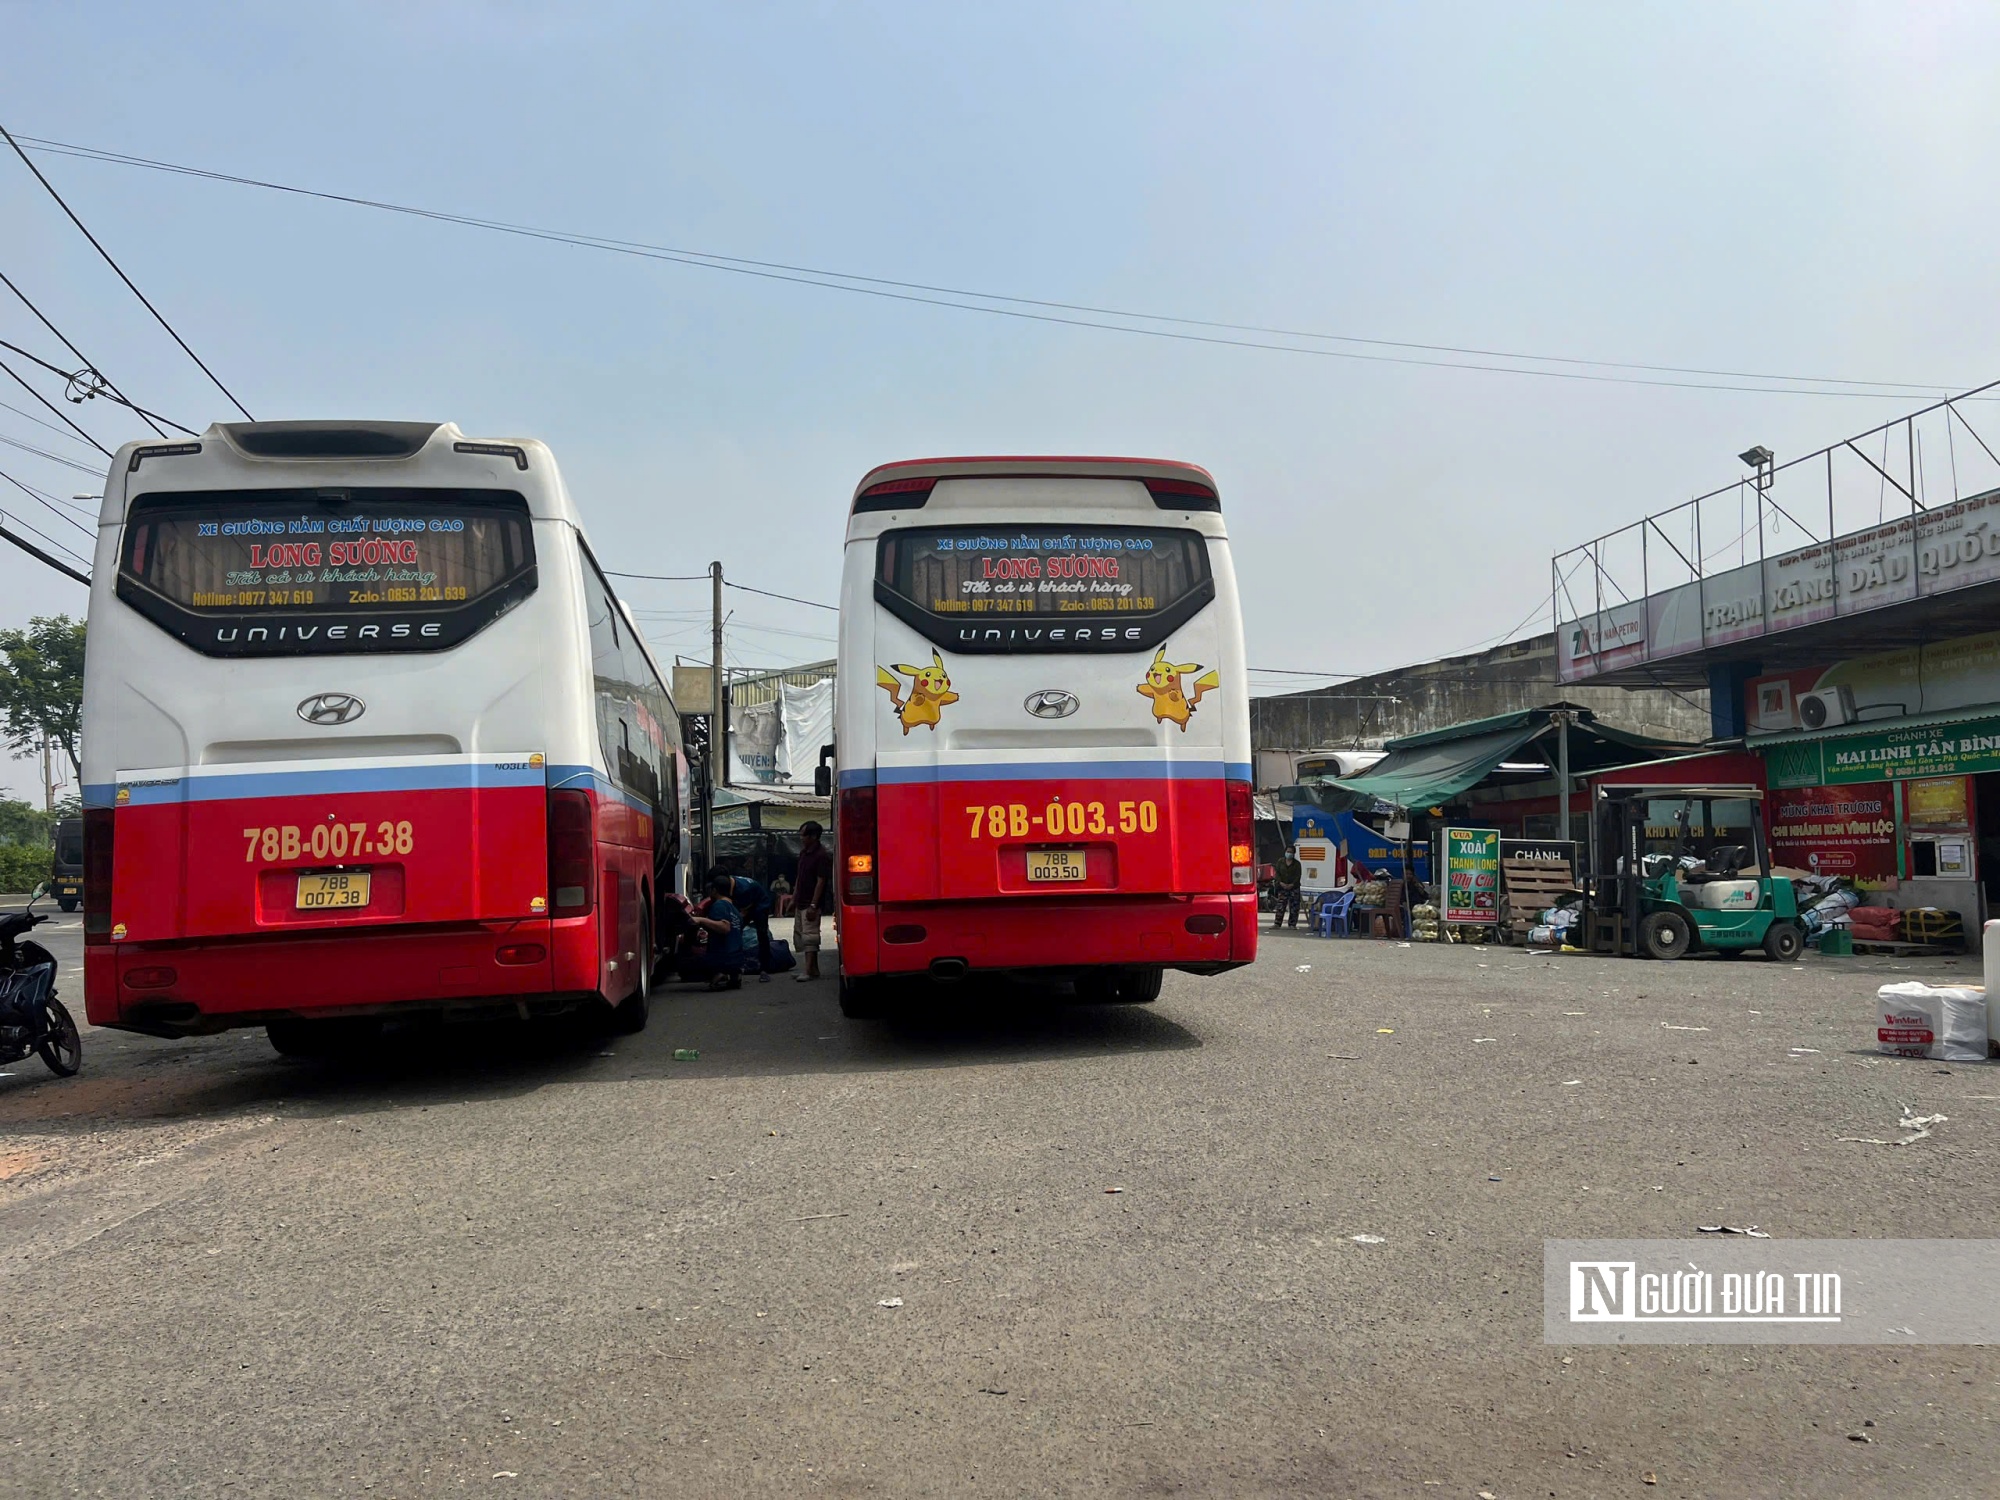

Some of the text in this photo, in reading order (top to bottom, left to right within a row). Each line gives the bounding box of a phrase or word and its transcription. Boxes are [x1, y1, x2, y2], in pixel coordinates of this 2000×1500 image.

[198, 515, 464, 536] XE GIƯỜNG NẰM CHẤT LƯỢNG CAO
[937, 533, 1153, 552] XE GIƯỜNG NẰM CHẤT LƯỢNG CAO
[250, 537, 418, 568] LONG SƯƠNG
[982, 553, 1119, 580] LONG SƯƠNG
[225, 568, 437, 586] Tất cả vì khách hàng
[238, 591, 266, 605] 0977
[268, 591, 290, 605] 347
[293, 590, 313, 604] 619
[387, 588, 417, 602] 0853
[420, 587, 441, 601] 201
[444, 587, 466, 600] 639
[962, 580, 1133, 596] Tất cả vì khách hàng
[934, 598, 971, 612] Hotline:
[972, 599, 994, 612] 0977
[997, 599, 1015, 612] 347
[1016, 598, 1034, 612] 619
[1091, 598, 1114, 611] 0853
[1117, 597, 1134, 611] 201
[1137, 597, 1155, 610] 639
[217, 623, 442, 642] UNIVERSE
[959, 627, 1142, 641] UNIVERSE
[1888, 729, 1944, 743] CHÀNH XE
[1836, 750, 1867, 765] MAI
[1870, 745, 1912, 762] LINH
[1915, 738, 1955, 757] TÂN
[1781, 800, 1882, 817] MỪNG KHAI TRƯƠNG
[965, 800, 1158, 839] 78B-003.50
[1771, 818, 1895, 837] CHI NHÁNH KCN VĨNH LỘC
[1645, 826, 1666, 838] KHU
[243, 820, 414, 863] 78B-007.38
[1459, 840, 1487, 855] XOÀI
[1043, 853, 1068, 865] 78B
[1514, 848, 1561, 860] CHÀNH
[1449, 857, 1498, 870] THANH LONG
[1034, 866, 1079, 879] 003.50
[1451, 871, 1474, 890] Mỹ
[319, 876, 349, 890] 78B
[305, 891, 360, 906] 007.38
[1884, 1014, 1924, 1025] WinMart
